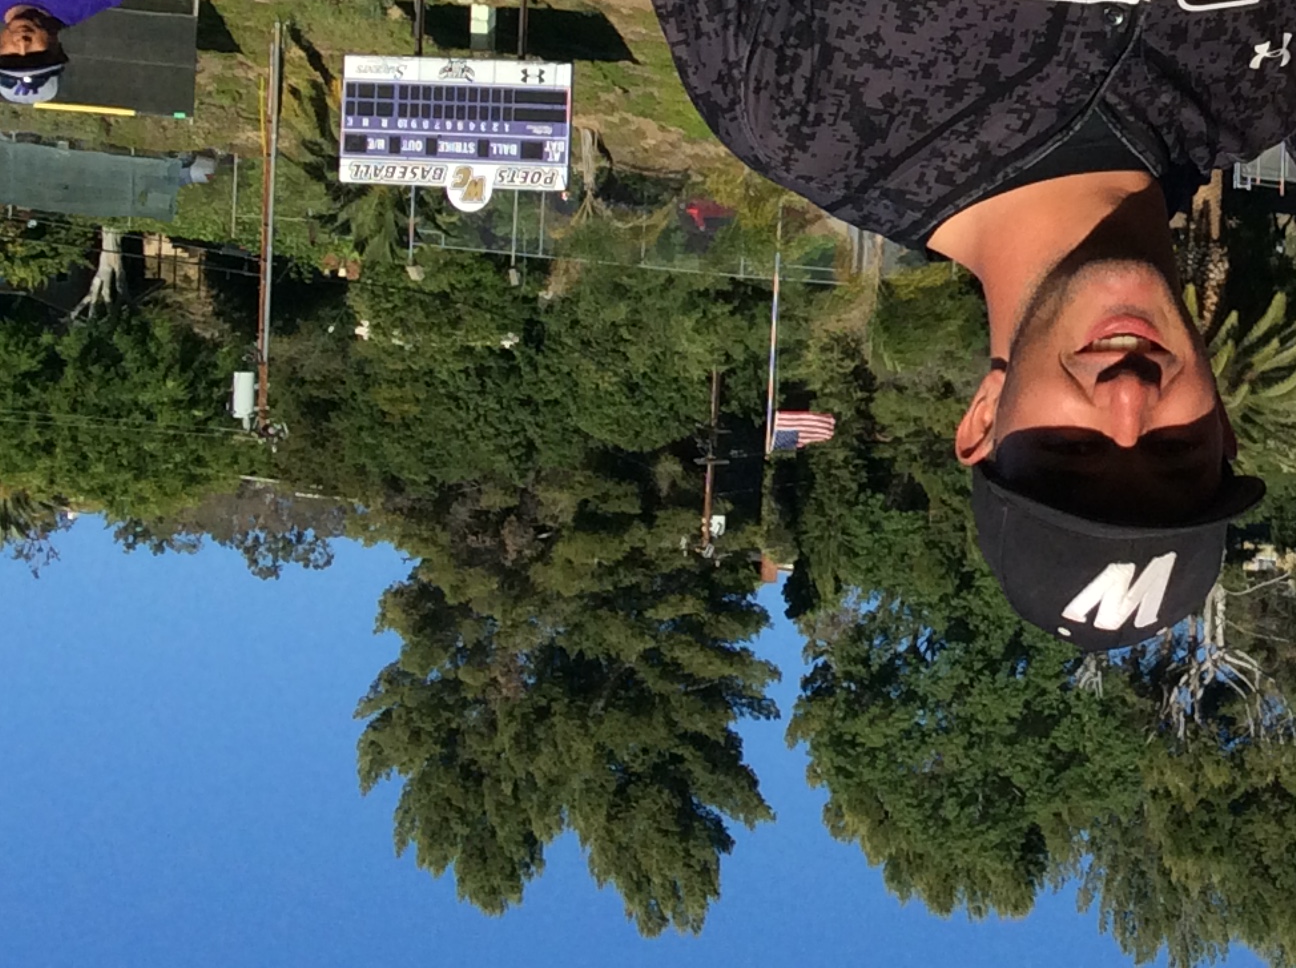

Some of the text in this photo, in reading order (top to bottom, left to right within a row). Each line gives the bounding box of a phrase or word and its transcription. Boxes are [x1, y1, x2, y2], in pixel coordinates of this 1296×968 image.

[401, 138, 423, 151] OUT
[438, 140, 475, 153] STRIKE
[490, 143, 517, 155] BALL
[544, 140, 565, 153] BAT
[546, 151, 561, 162] AT
[351, 164, 556, 185] POETS BASEBALL
[1061, 551, 1177, 630] W
